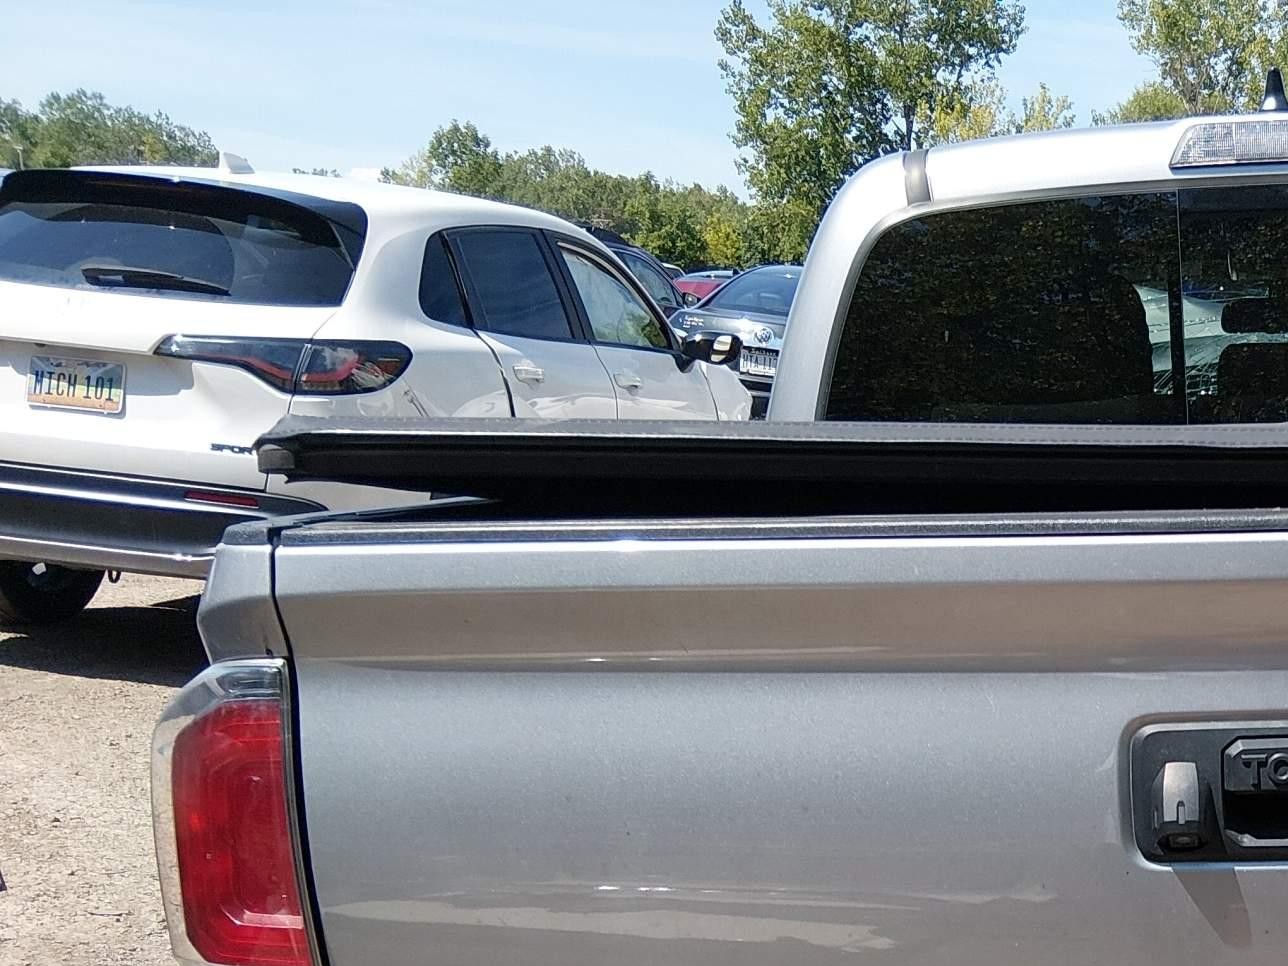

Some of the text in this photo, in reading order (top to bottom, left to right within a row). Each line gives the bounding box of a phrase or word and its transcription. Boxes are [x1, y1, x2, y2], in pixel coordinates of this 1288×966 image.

[33, 370, 115, 402] MICH 101
[210, 443, 254, 455] SPOR
